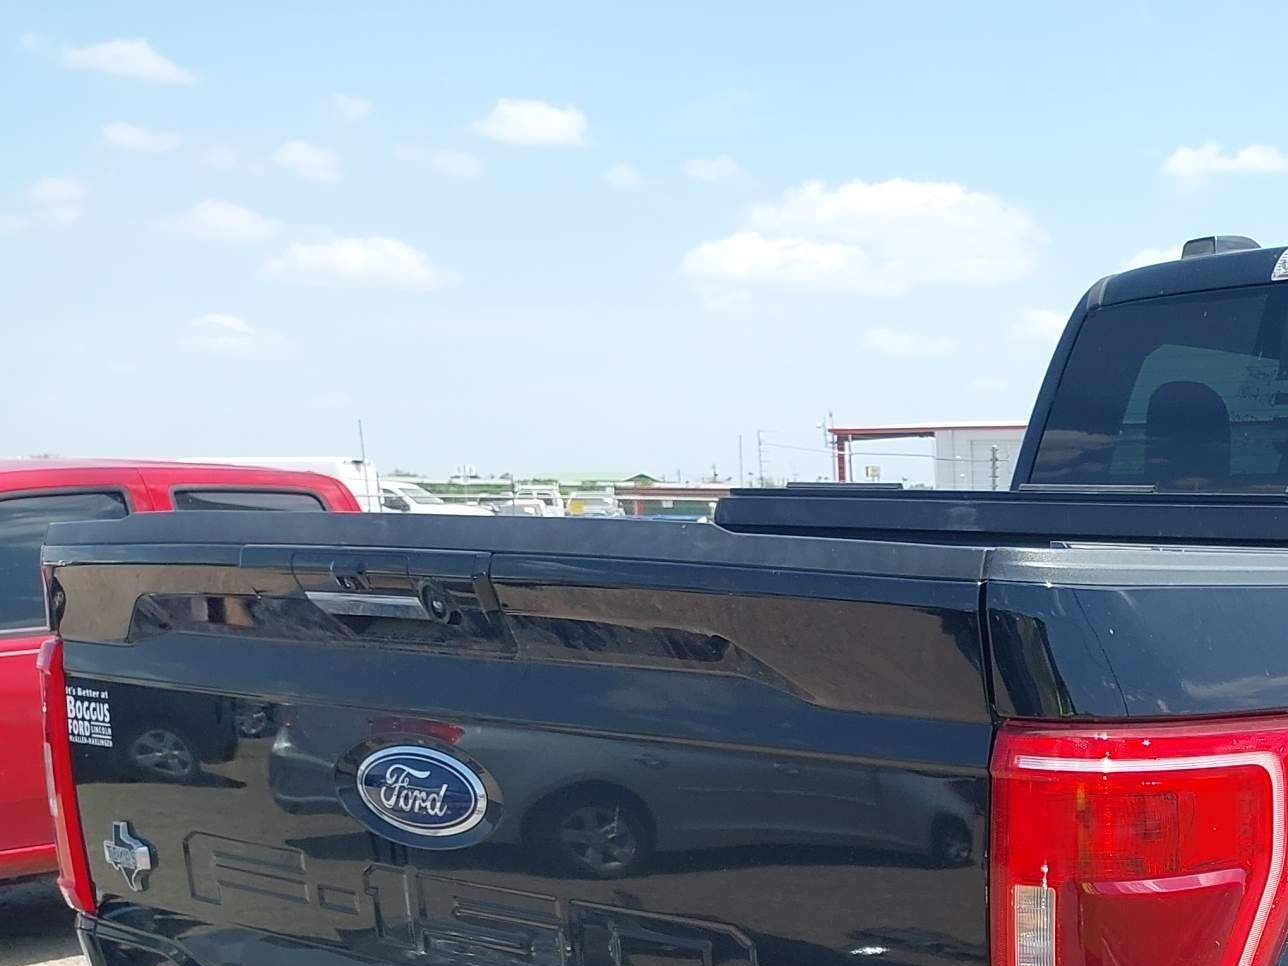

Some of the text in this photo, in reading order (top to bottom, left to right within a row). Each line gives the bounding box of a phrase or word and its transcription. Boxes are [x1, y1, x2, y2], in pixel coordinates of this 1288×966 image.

[77, 687, 99, 698] Better
[100, 690, 109, 699] at
[66, 695, 110, 723] BOGGUS
[68, 719, 113, 736] FORD LINCOLN
[380, 763, 450, 817] Ford
